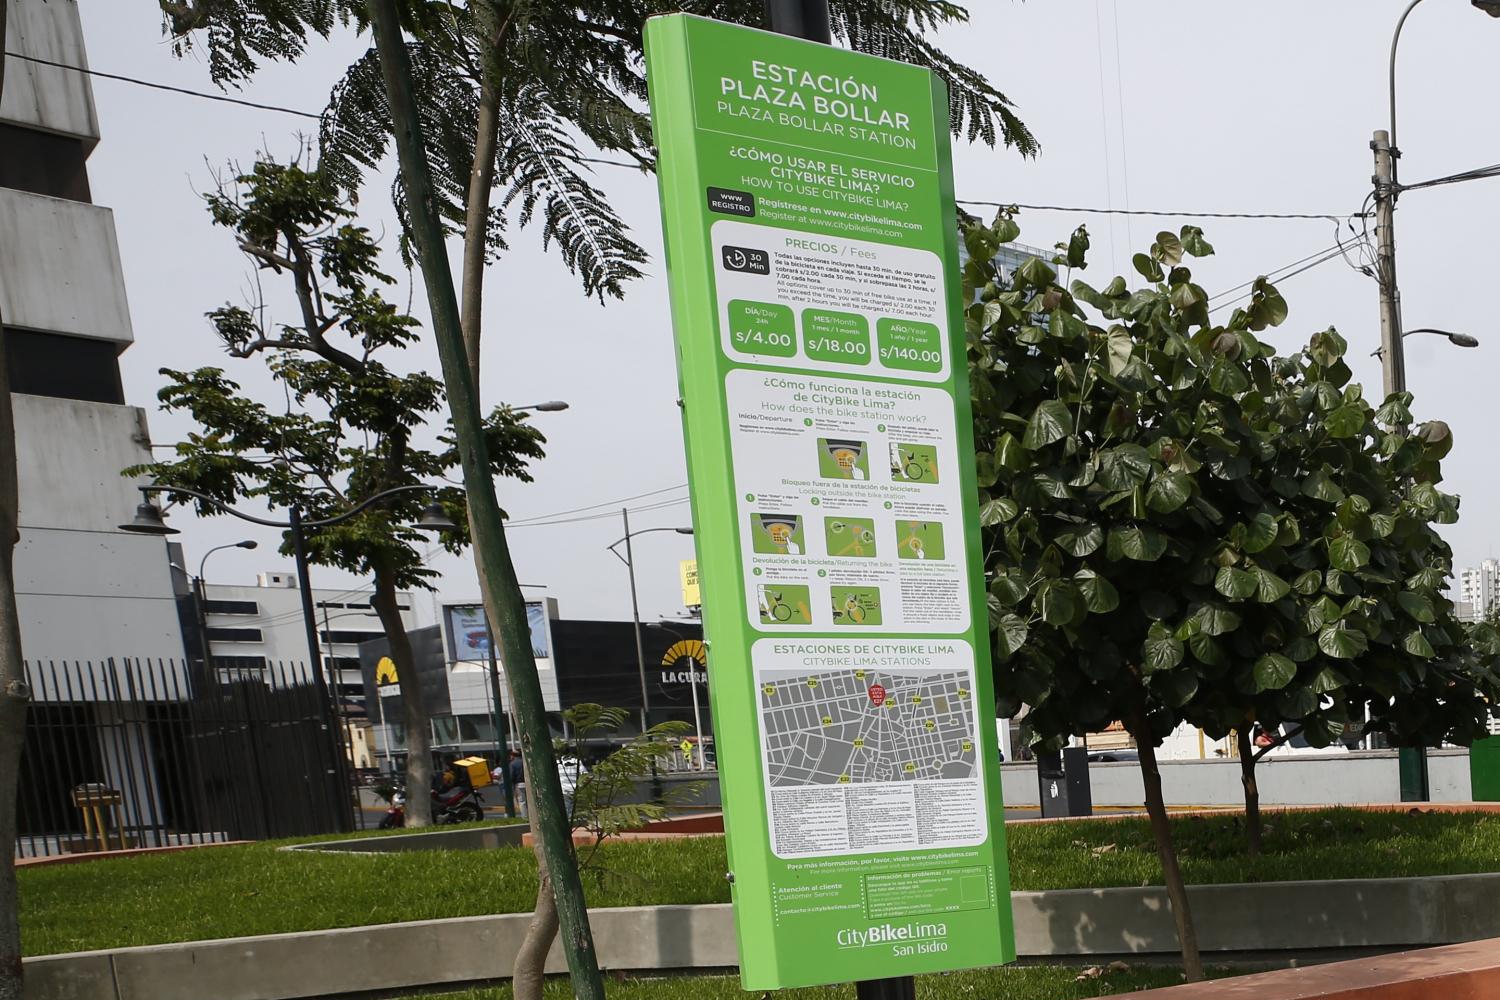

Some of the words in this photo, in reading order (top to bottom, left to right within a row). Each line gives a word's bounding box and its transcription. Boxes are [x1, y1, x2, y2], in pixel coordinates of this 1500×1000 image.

[752, 60, 877, 102] ESTACIÓN
[721, 77, 806, 110] PLAZA
[814, 96, 910, 131] BOLLAR
[718, 101, 774, 123] PLAZA
[779, 113, 844, 136] BOLLAR
[850, 127, 916, 149] STATION
[730, 146, 783, 165] ¿CÓMO
[788, 156, 825, 172] USAR
[831, 164, 847, 176] EL
[852, 168, 915, 188] SERVICIO
[771, 167, 835, 186] CITYBIKE
[840, 180, 880, 194] LIMA?
[742, 176, 772, 189] HOW
[776, 181, 793, 192] TO
[797, 185, 819, 197] USE
[823, 190, 873, 206] CITYBIKE
[877, 199, 908, 211] LIMA?
[712, 200, 750, 212] REGISTRO
[760, 209, 796, 222] Register
[798, 215, 807, 223] at
[810, 217, 902, 238] www.citybikelima.com
[810, 206, 821, 214] en
[824, 208, 922, 231] www.citybikelima.com
[786, 238, 838, 254] PRECIOS
[851, 248, 876, 259] Fees
[736, 329, 790, 346] s/4.00
[809, 337, 866, 354] s/18.00
[881, 345, 940, 363] s/140.00
[764, 378, 805, 390] ¿Cómo
[809, 382, 858, 395] funciona
[861, 387, 871, 397] la
[874, 389, 921, 401] estación
[793, 393, 808, 402] de
[812, 394, 860, 407] CityBike
[863, 399, 896, 410] Lima?
[761, 401, 786, 412] How
[789, 404, 814, 414] does
[817, 407, 834, 416] the
[836, 409, 858, 418] bike
[860, 410, 895, 422] station
[897, 414, 927, 424] work?
[782, 478, 811, 487] Bloqueo
[812, 480, 830, 488] fuera
[890, 485, 921, 493] bicicletas
[752, 557, 789, 565] Devolución
[774, 645, 851, 654] ESTACIONES
[854, 645, 869, 654] DE
[873, 645, 925, 654] CITYBIKE
[928, 645, 955, 654] LIMA
[803, 657, 850, 666] CITYBIKE
[854, 658, 878, 666] LIMA
[881, 658, 931, 666] STATIONS
[662, 672, 677, 683] LA
[778, 886, 810, 894] Atención
[837, 922, 946, 947] CityBikeLima
[893, 945, 914, 956] San
[917, 940, 948, 954] Isidro
